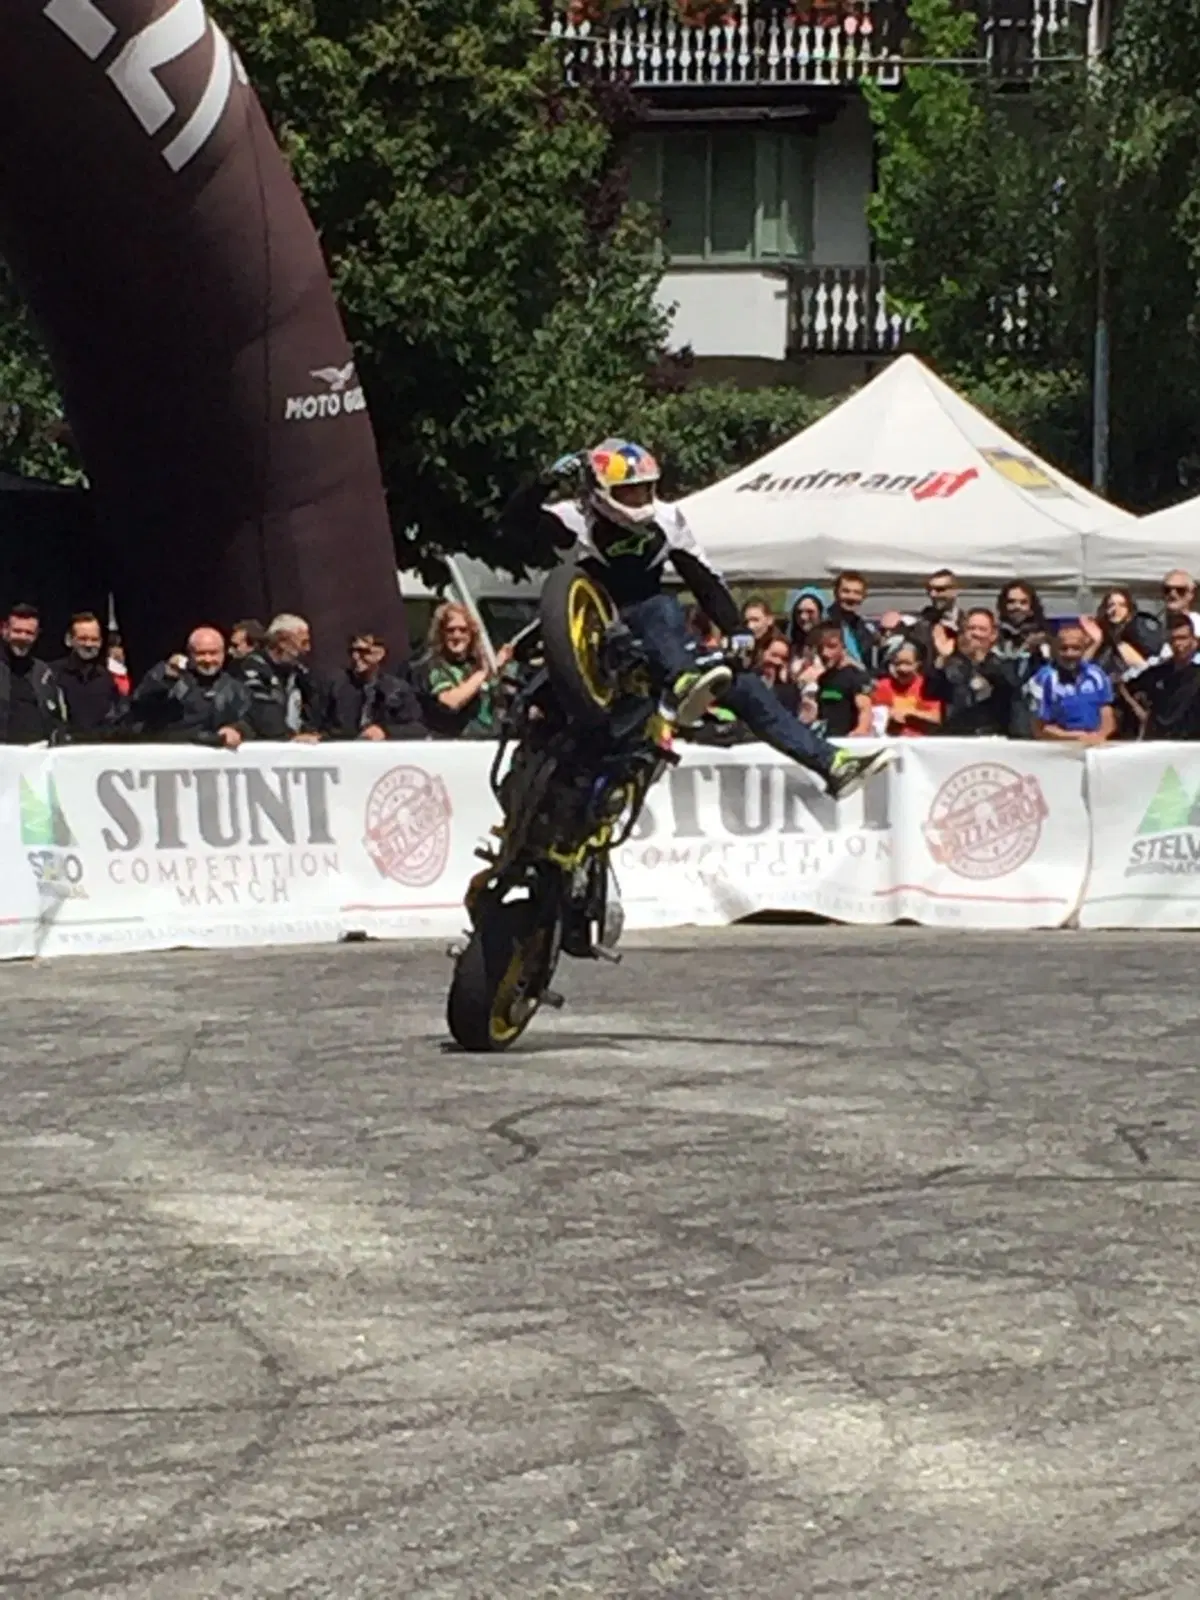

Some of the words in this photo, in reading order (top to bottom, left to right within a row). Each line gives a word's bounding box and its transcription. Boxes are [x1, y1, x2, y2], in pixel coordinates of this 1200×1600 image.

[285, 393, 340, 419] MOTO
[96, 765, 340, 852] STUNT
[107, 850, 342, 885] COMPETITION
[176, 876, 291, 906] MATCH
